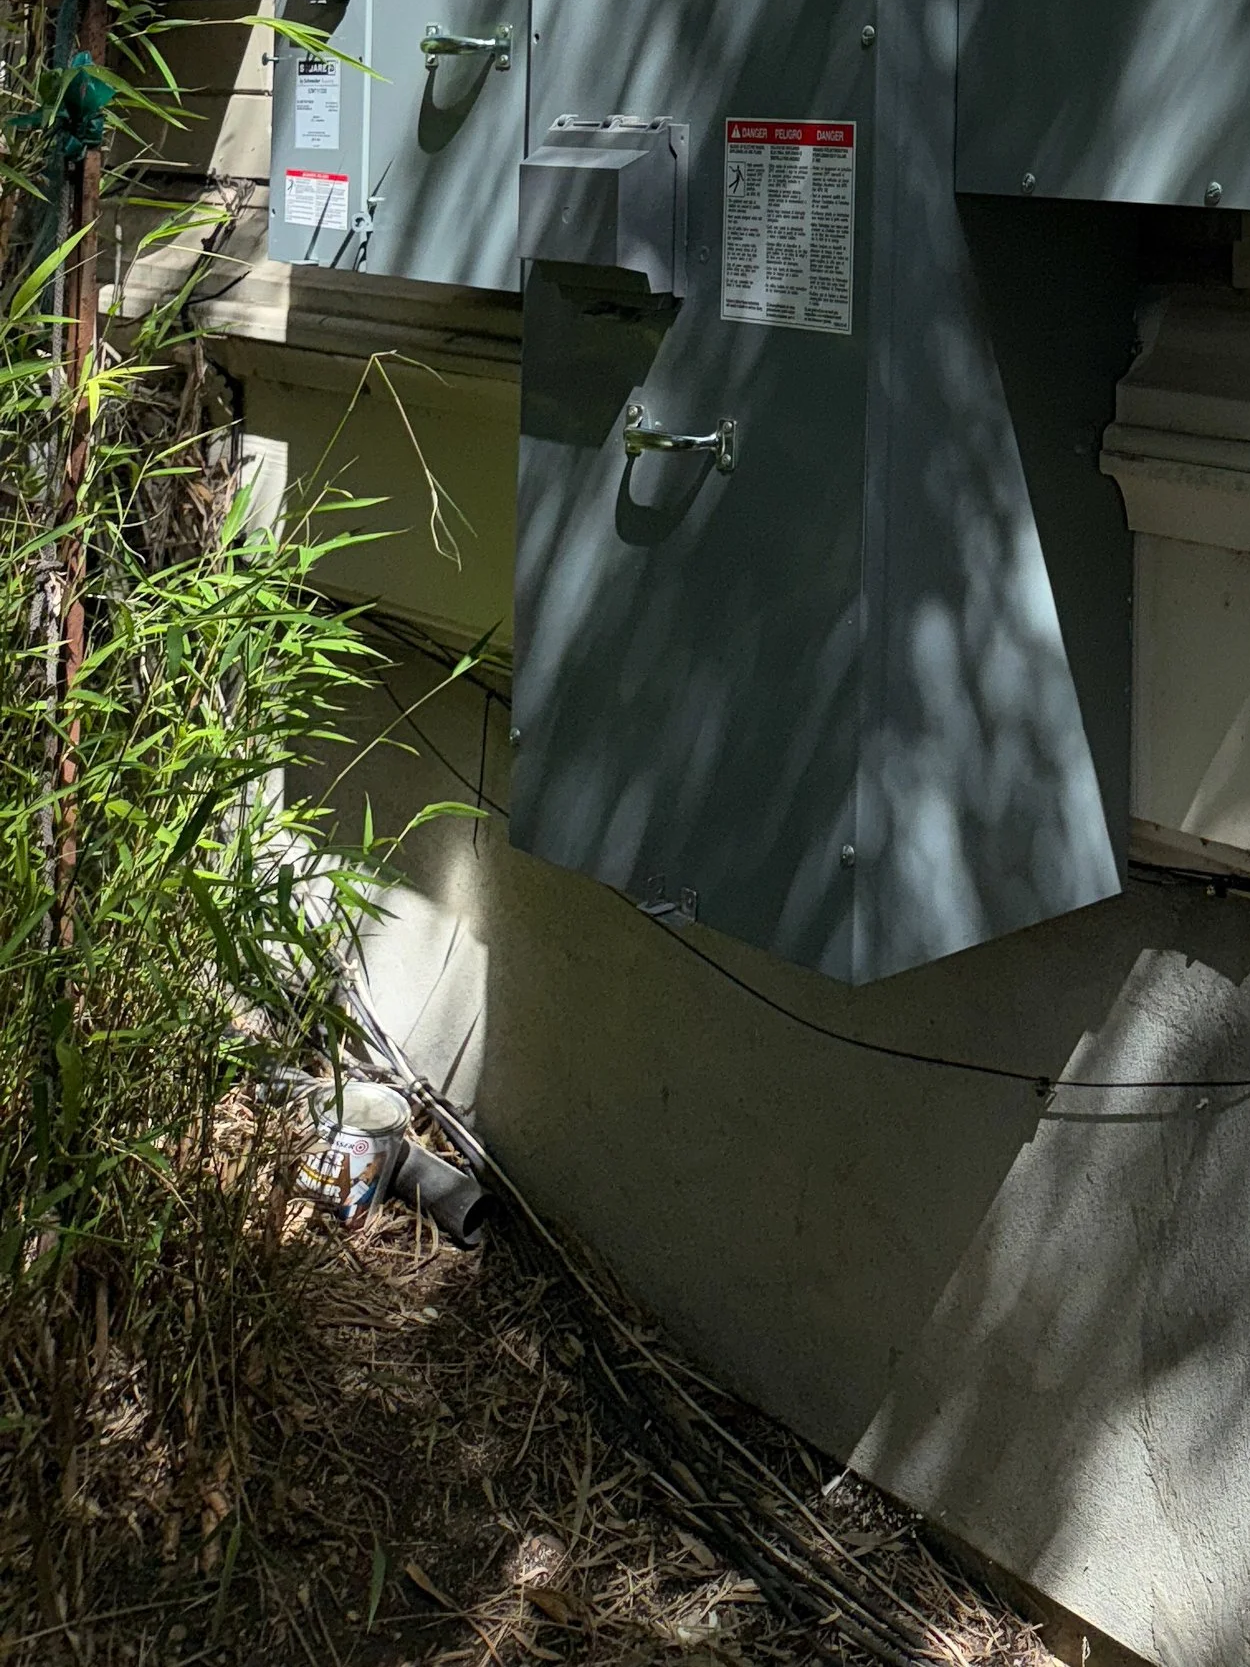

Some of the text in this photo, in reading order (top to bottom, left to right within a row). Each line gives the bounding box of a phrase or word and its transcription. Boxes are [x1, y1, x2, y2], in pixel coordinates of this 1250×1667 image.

[742, 127, 768, 138] DANGER
[775, 129, 802, 140] PELIGRO
[816, 130, 844, 142] DANGER
